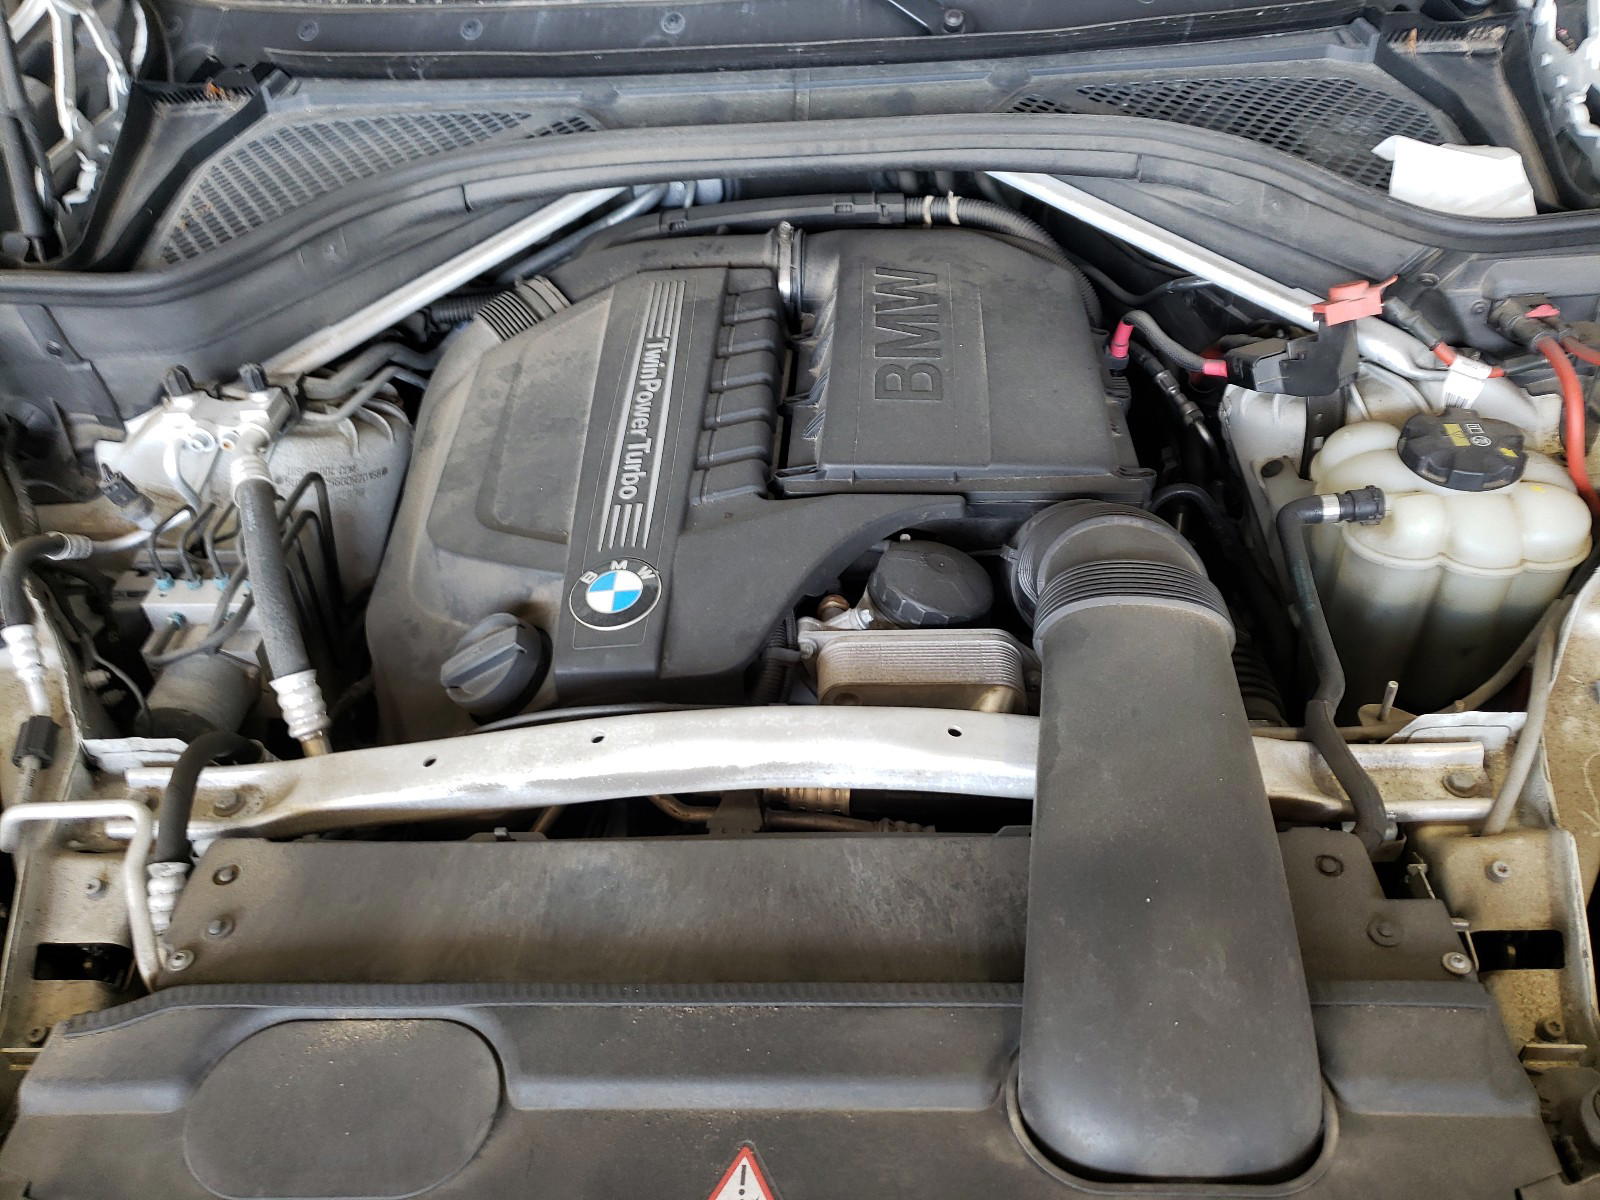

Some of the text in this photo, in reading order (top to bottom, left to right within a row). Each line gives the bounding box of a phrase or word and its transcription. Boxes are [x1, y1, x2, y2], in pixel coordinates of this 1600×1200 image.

[873, 266, 944, 401] BMW
[618, 337, 670, 500] TwinPower Turbo
[579, 560, 657, 585] BMW
